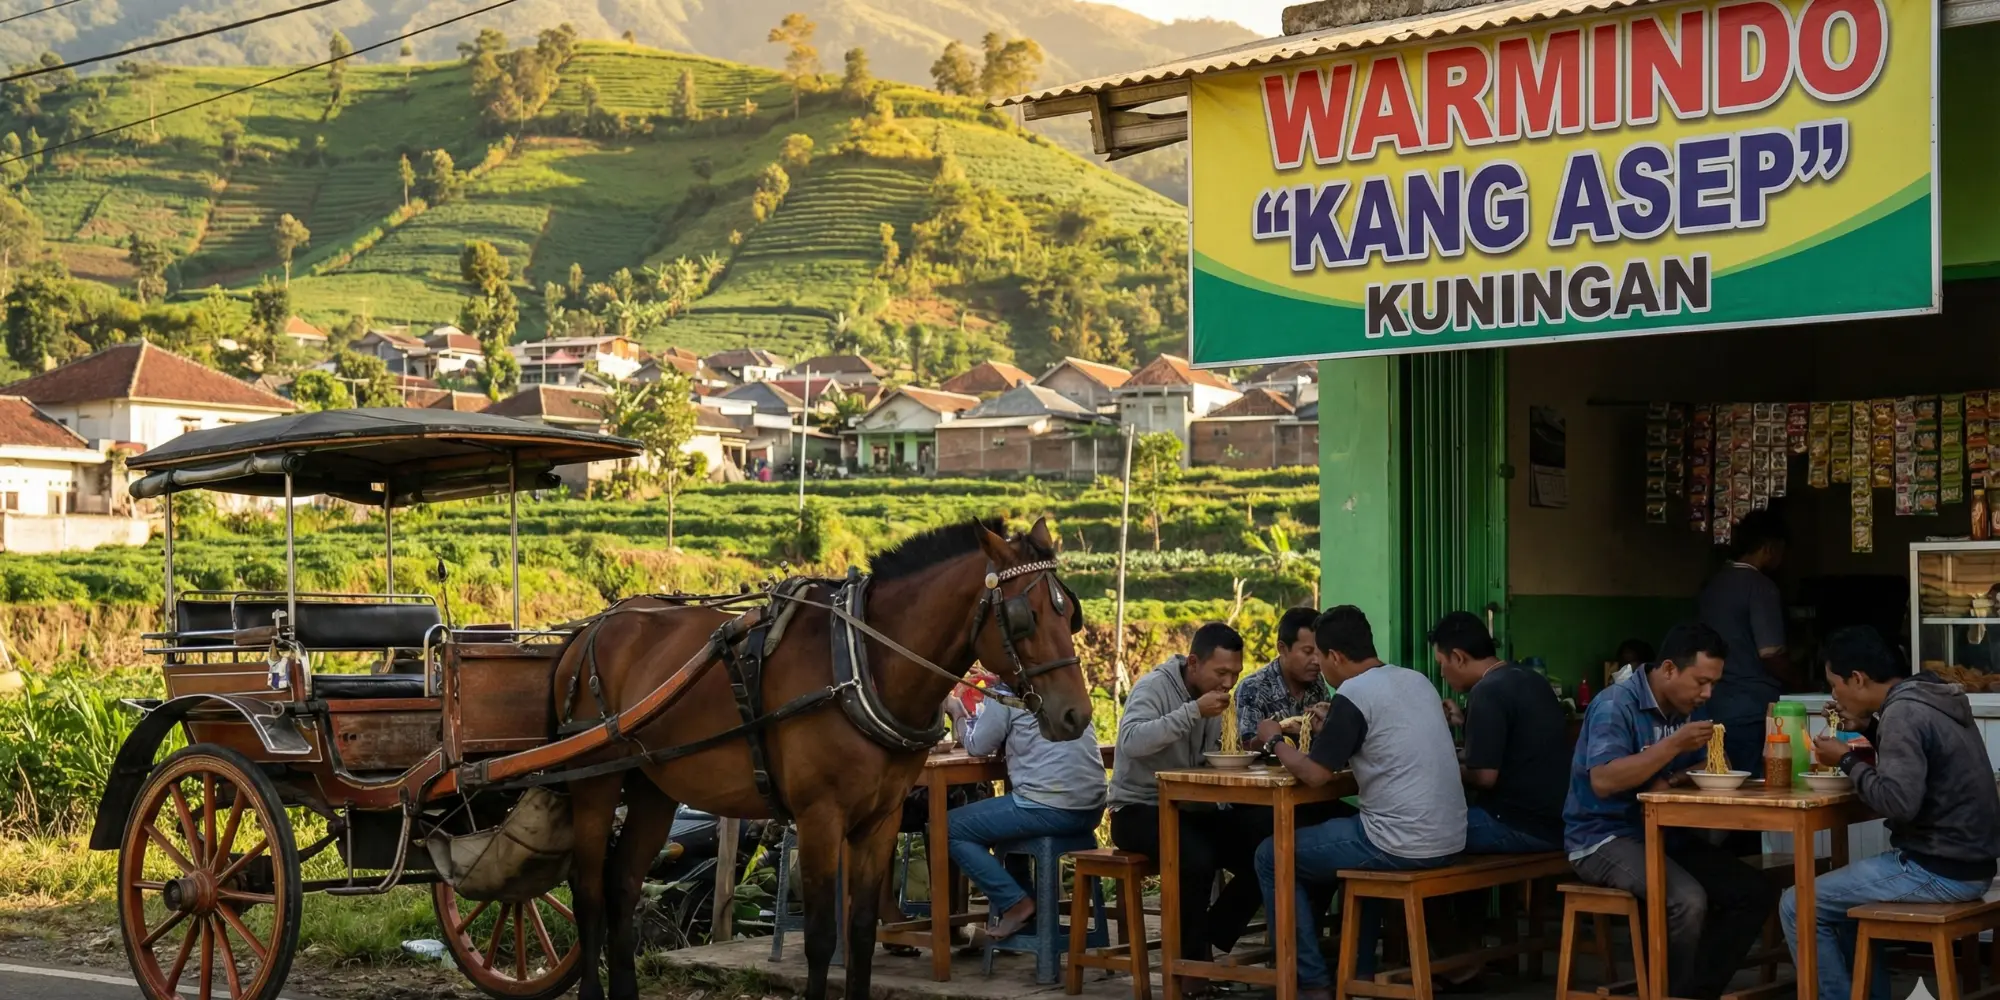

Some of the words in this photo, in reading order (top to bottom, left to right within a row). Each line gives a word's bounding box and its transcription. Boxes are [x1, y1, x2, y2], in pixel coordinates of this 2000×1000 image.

[1264, 0, 1882, 165] WARMINDO
[1256, 164, 1527, 266] “KANG
[1552, 123, 1845, 241] ASEP”
[1368, 256, 1708, 335] KUNINGAN
